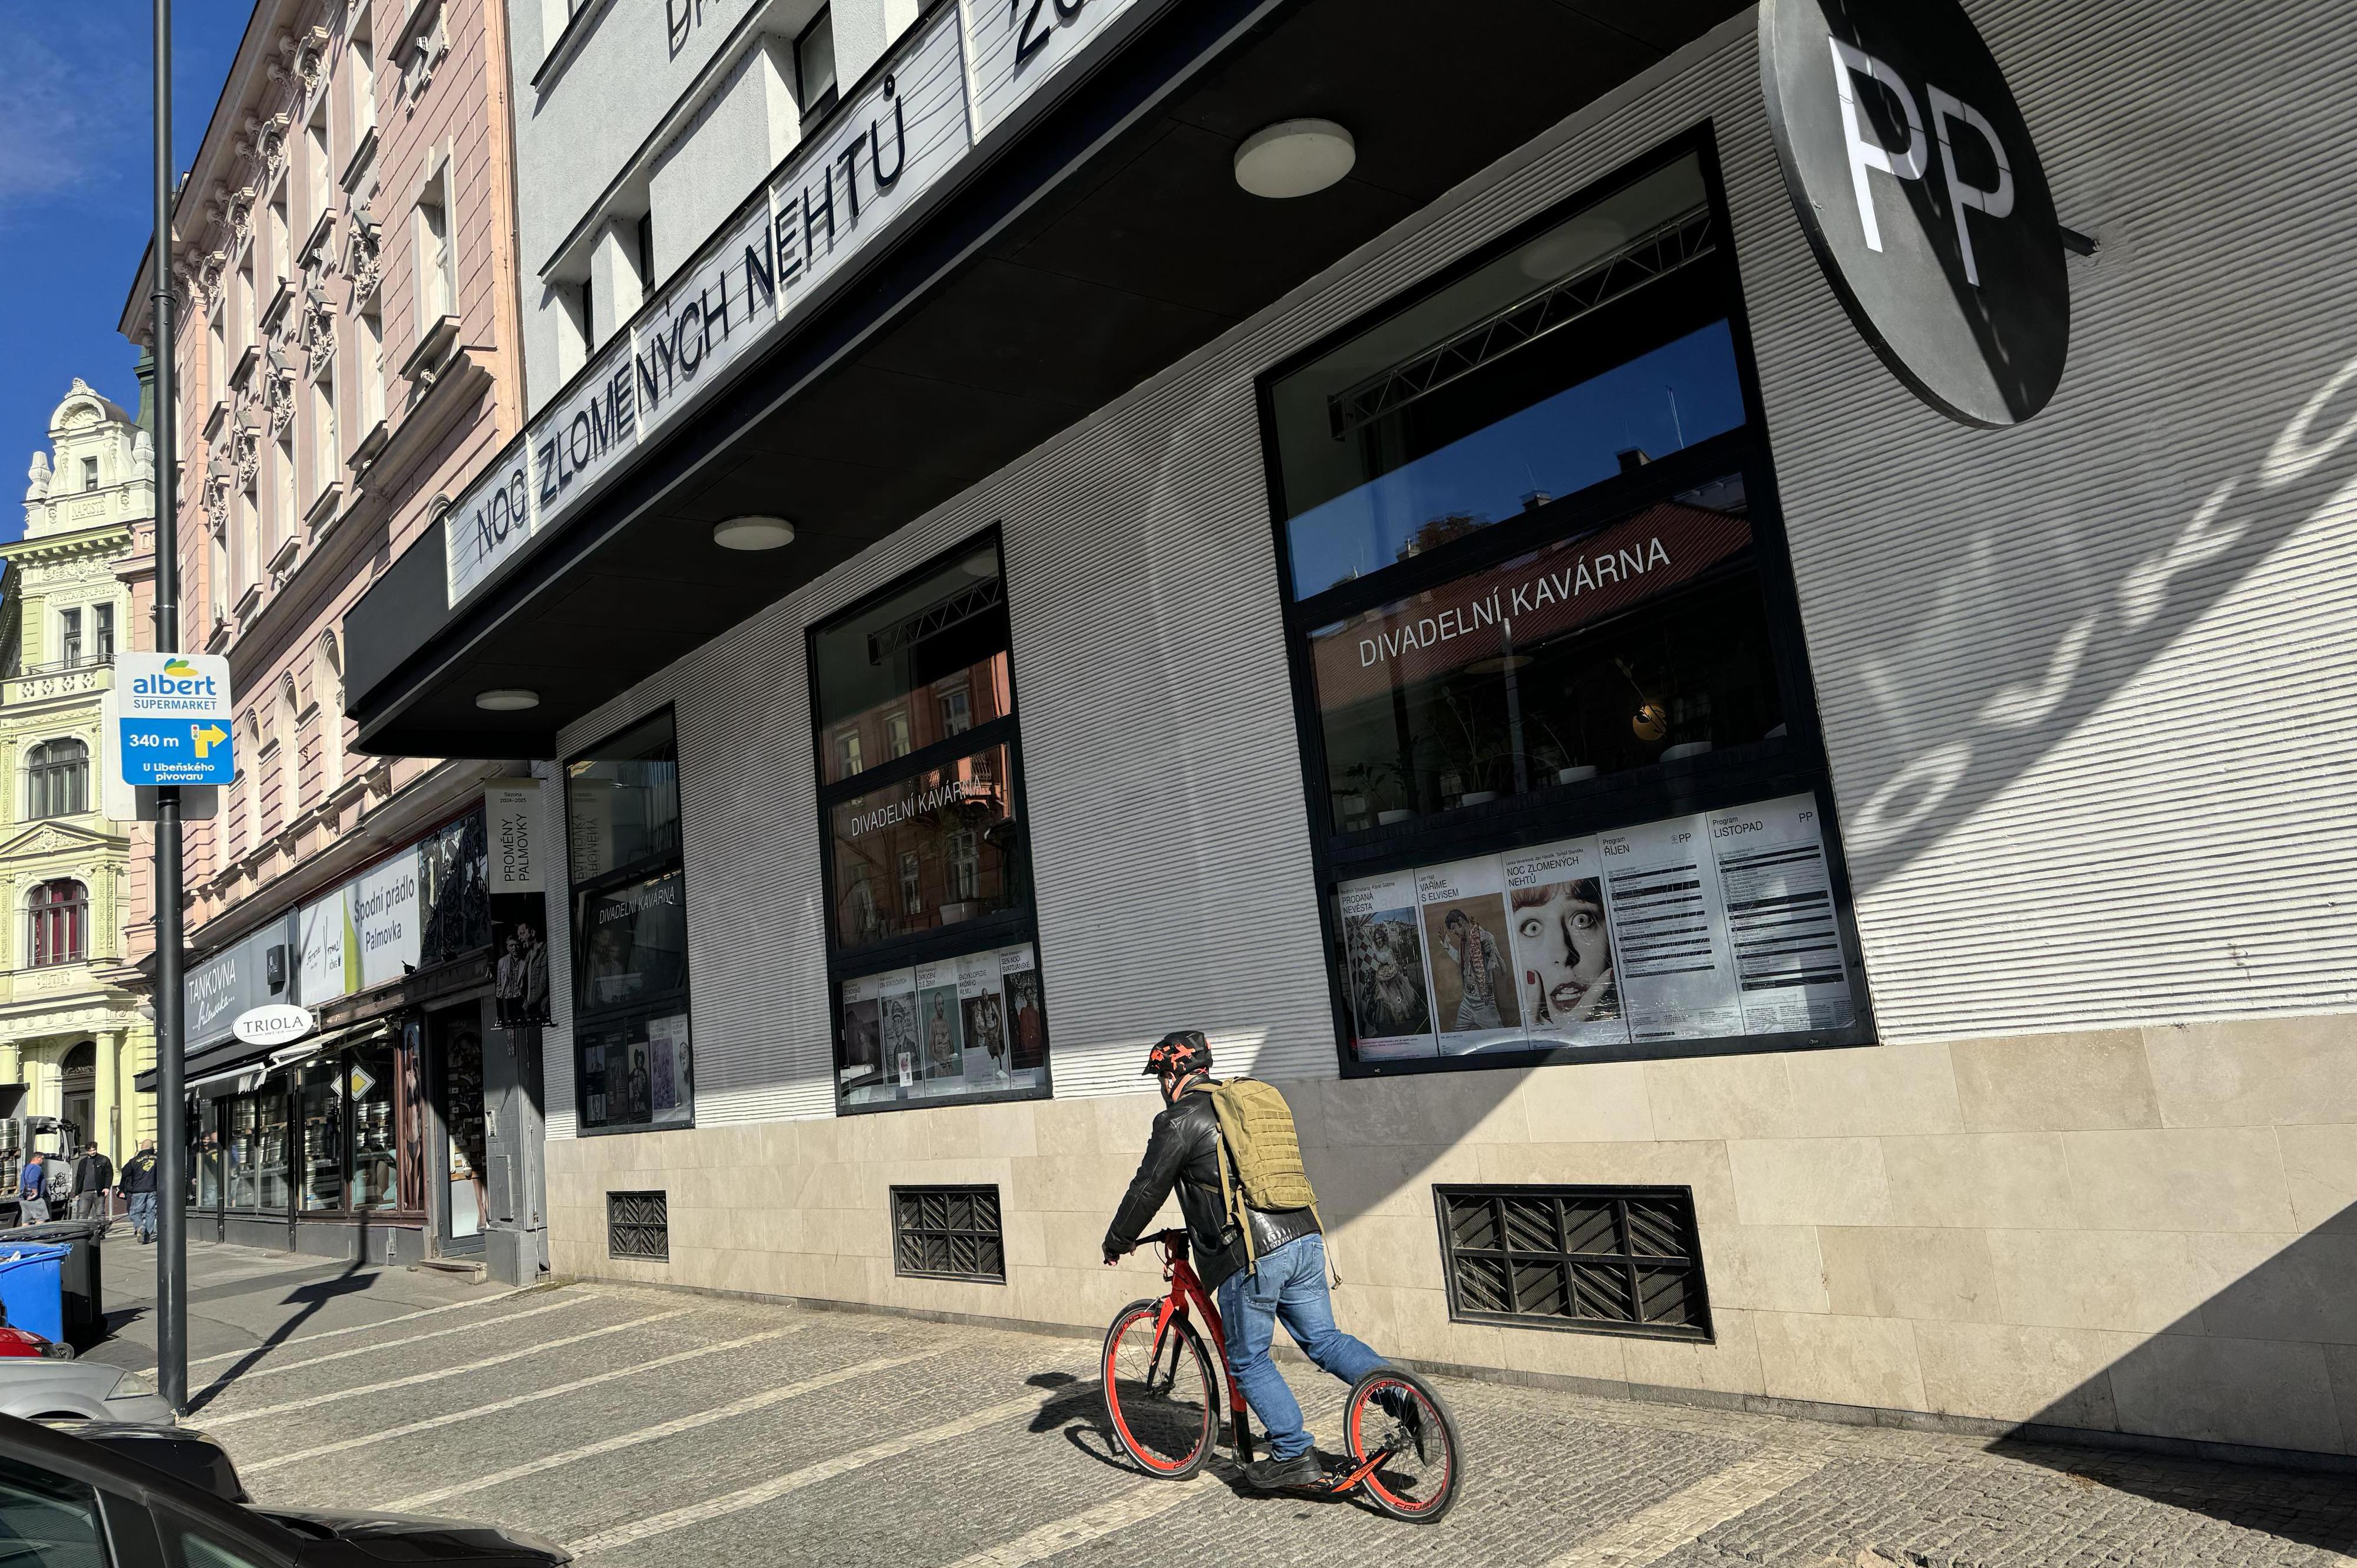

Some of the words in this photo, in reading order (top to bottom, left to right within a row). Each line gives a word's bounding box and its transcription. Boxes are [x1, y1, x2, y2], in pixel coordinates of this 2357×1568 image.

[1829, 35, 2014, 286] PP
[477, 468, 526, 560] NOC
[537, 270, 728, 504] ZLOMENÝCH
[745, 74, 905, 313] NEHTŮ
[1359, 586, 1502, 667] DIVADELNÍ
[1511, 537, 1671, 616] KAVÁRNA
[133, 674, 217, 696] albert
[133, 699, 217, 710] SUPERMARKET
[129, 734, 160, 747] 340
[163, 737, 179, 747] m
[143, 763, 150, 771] U
[153, 762, 215, 772] Libeňského
[156, 773, 203, 783] pivovaru
[851, 792, 915, 837] DIVADELNÍ
[918, 774, 982, 814] KAVÁRNA
[1712, 816, 1738, 826] Program
[1798, 811, 1813, 823] PP
[1679, 833, 1692, 843] PP
[1714, 821, 1764, 839] LISTOPAD
[516, 813, 530, 881] PALMOVKY
[1603, 836, 1626, 846] Program
[500, 818, 516, 882] PROMĚNY
[1604, 844, 1630, 857] ŘÍJEN
[1507, 866, 1526, 877] NOC
[1527, 856, 1580, 874] ZLOMENÝCH
[1420, 879, 1447, 892] VAŘÍME
[1508, 873, 1537, 887] NEHTŮ
[354, 886, 383, 928] Spodní
[386, 874, 414, 916] prádlo
[1342, 890, 1374, 905] PRODANÁ
[1421, 894, 1427, 903] S
[1429, 888, 1460, 902] ELVISEM
[599, 895, 637, 924] DIVADELNÍ
[638, 886, 675, 912] KAVÁRNA
[1343, 902, 1374, 914] NEVĚSTA
[365, 920, 402, 953] Palmovka
[189, 958, 236, 1004] TANKOVNA
[243, 1016, 304, 1033] TRIOLA
